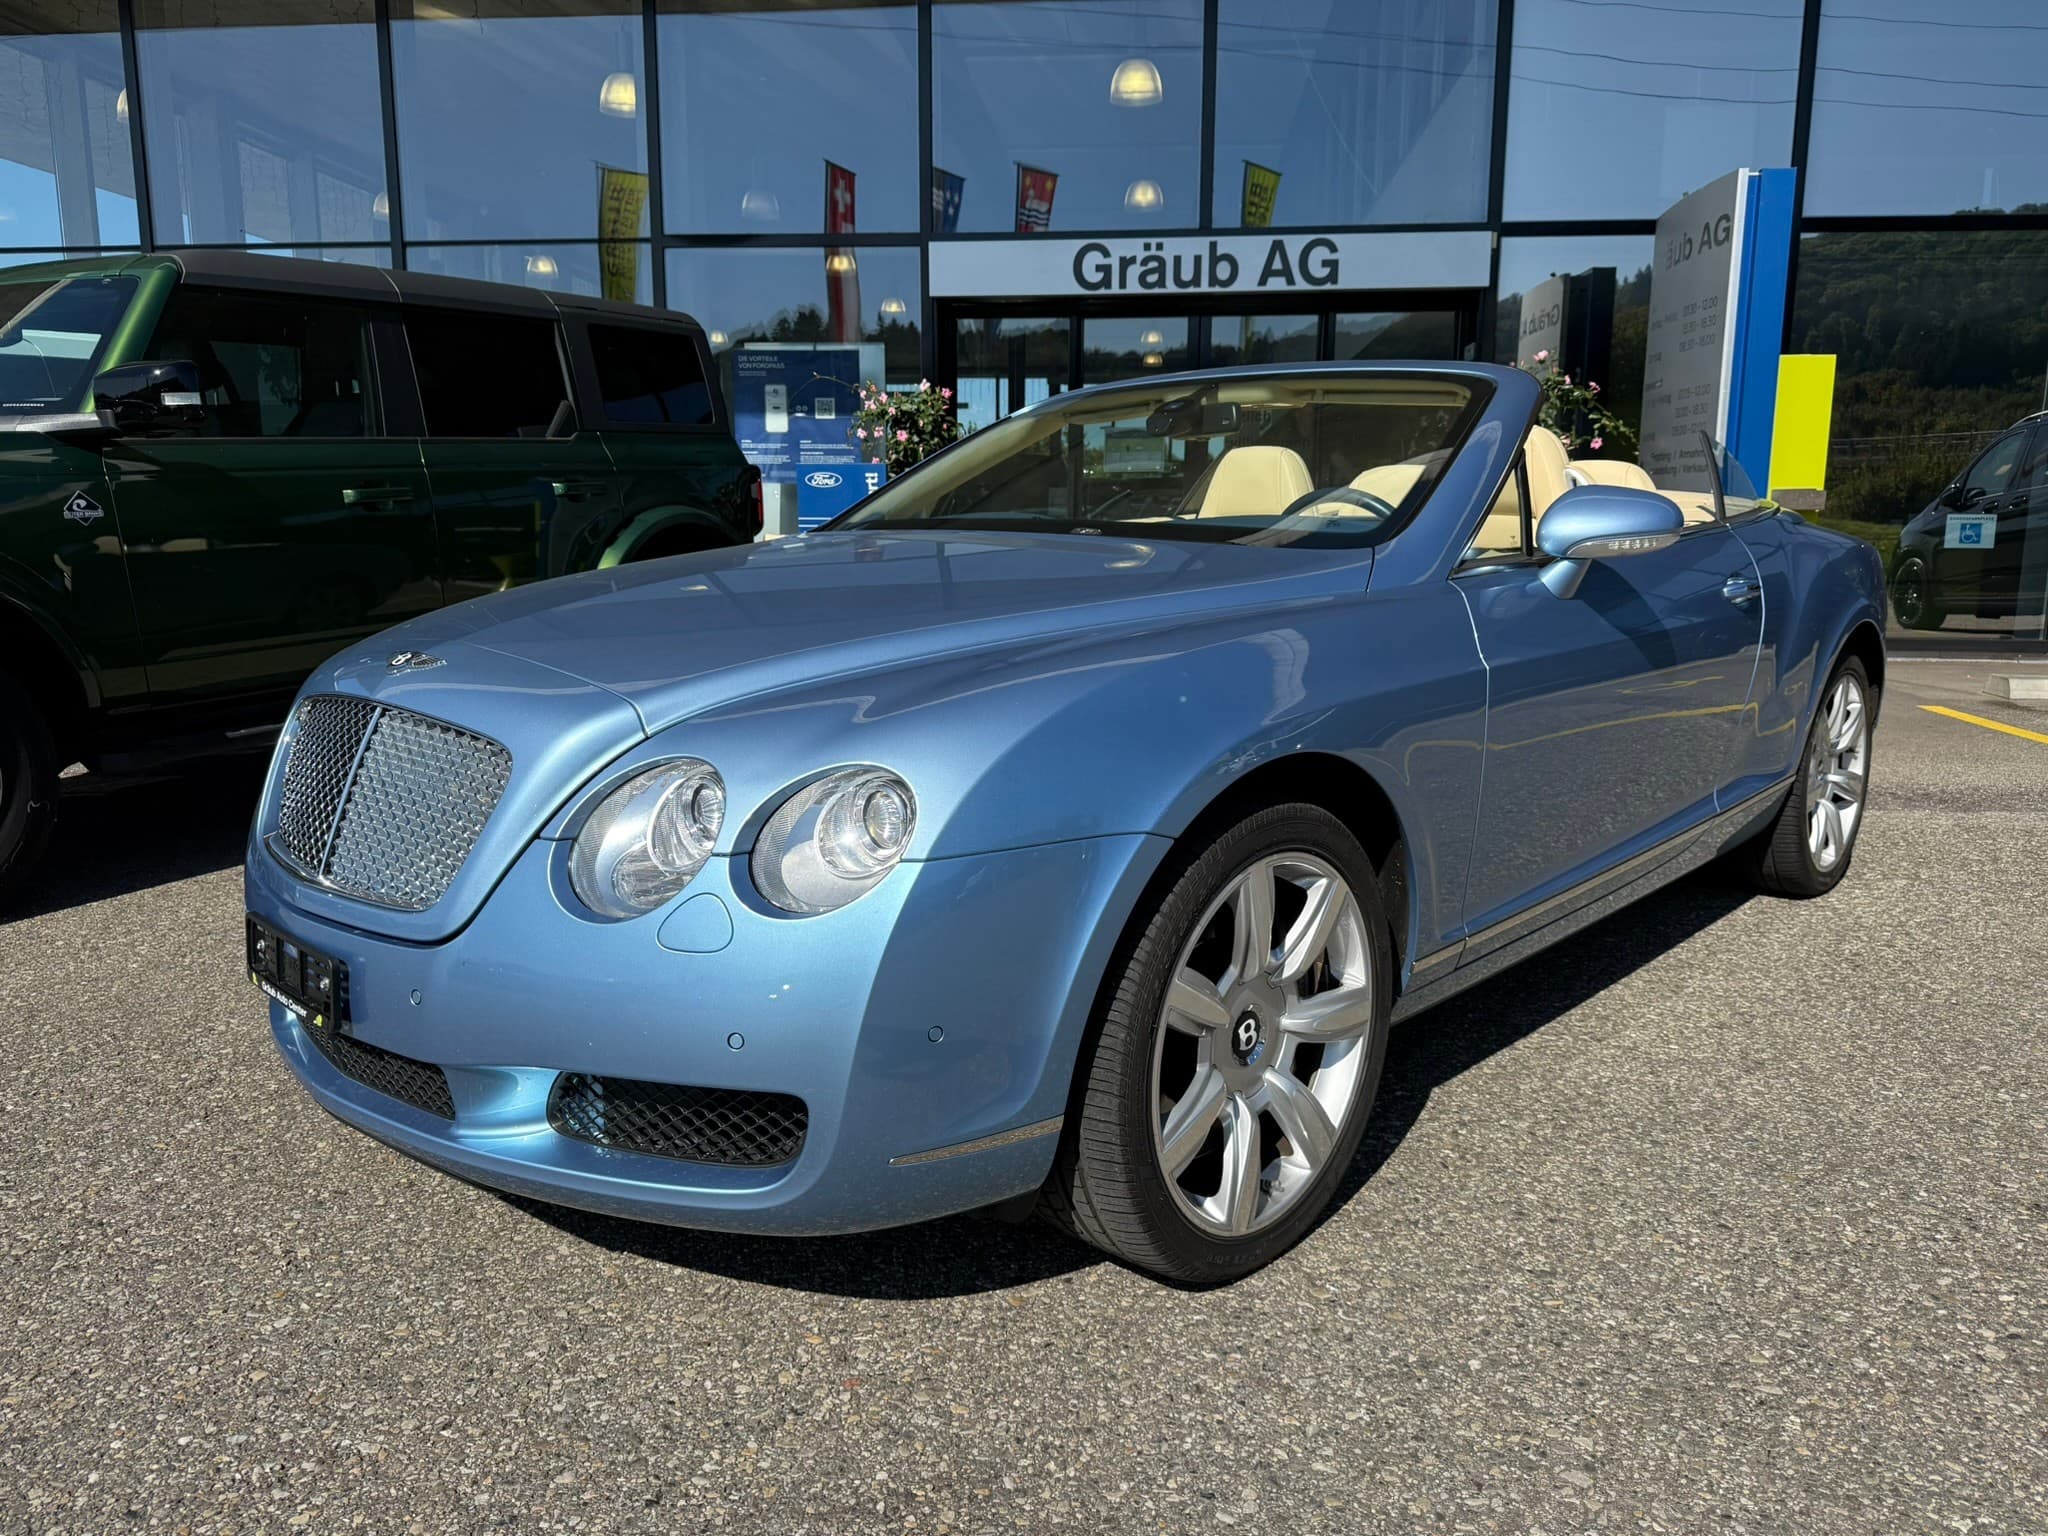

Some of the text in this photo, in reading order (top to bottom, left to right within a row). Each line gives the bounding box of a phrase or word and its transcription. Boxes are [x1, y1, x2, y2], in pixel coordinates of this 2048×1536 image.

[1698, 213, 1731, 254] AG
[1073, 237, 1339, 291] Gräub AG
[1238, 1018, 1257, 1050] B
